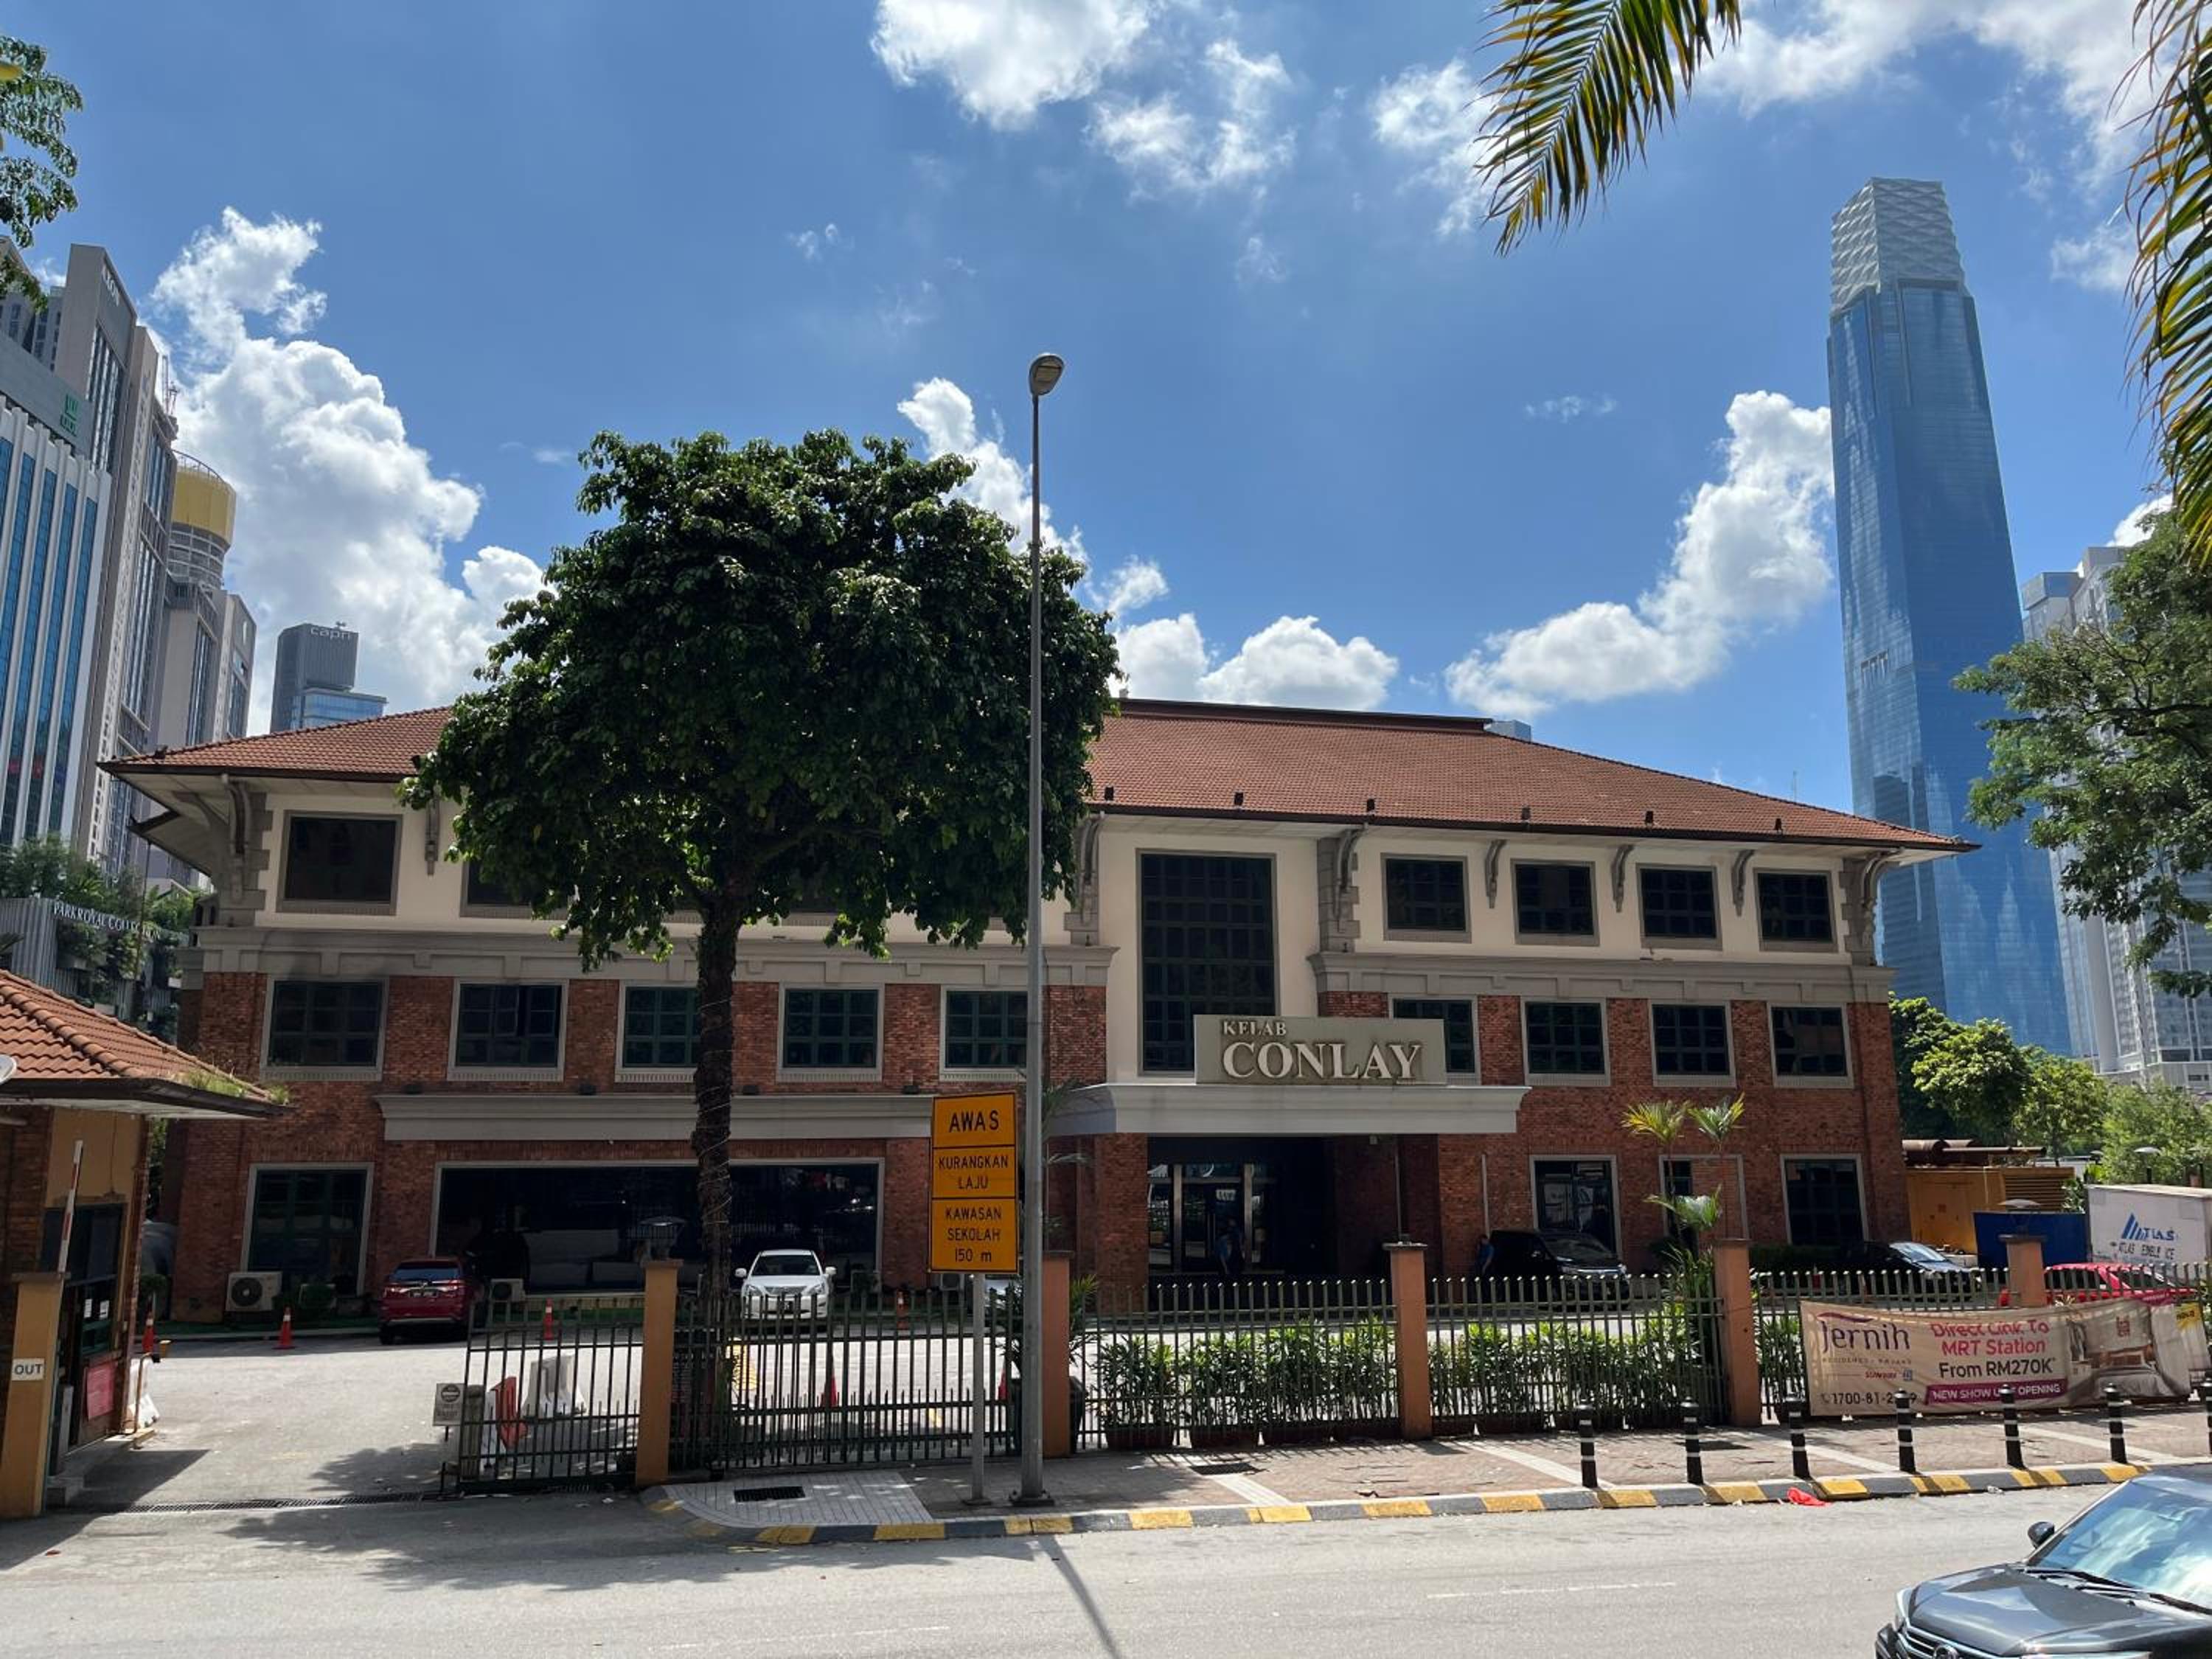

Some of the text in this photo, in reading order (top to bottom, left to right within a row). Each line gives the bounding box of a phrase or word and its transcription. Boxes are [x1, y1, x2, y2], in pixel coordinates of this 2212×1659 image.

[54, 900, 106, 927] PARKROYAL
[1222, 1020, 1287, 1036] KELAB
[1222, 1041, 1421, 1079] CONLAY
[949, 1110, 999, 1133] AWAS
[939, 1155, 1008, 1169] KURANGKAN
[958, 1175, 988, 1189] LAJU
[945, 1206, 1002, 1220] KAWASAN
[947, 1227, 1001, 1241] SEKOLAH
[955, 1248, 992, 1262] 150 m
[1930, 1322, 1984, 1338] Direct
[2028, 1319, 2049, 1333] To
[1821, 1321, 1910, 1354] Jernih
[1941, 1338, 2045, 1356] MRT Station
[14, 1363, 42, 1376] OUT
[1939, 1362, 1983, 1378] From
[1933, 1388, 1958, 1400] NEW
[1960, 1388, 1992, 1399] SHOW
[2017, 1383, 2061, 1395] OPENING
